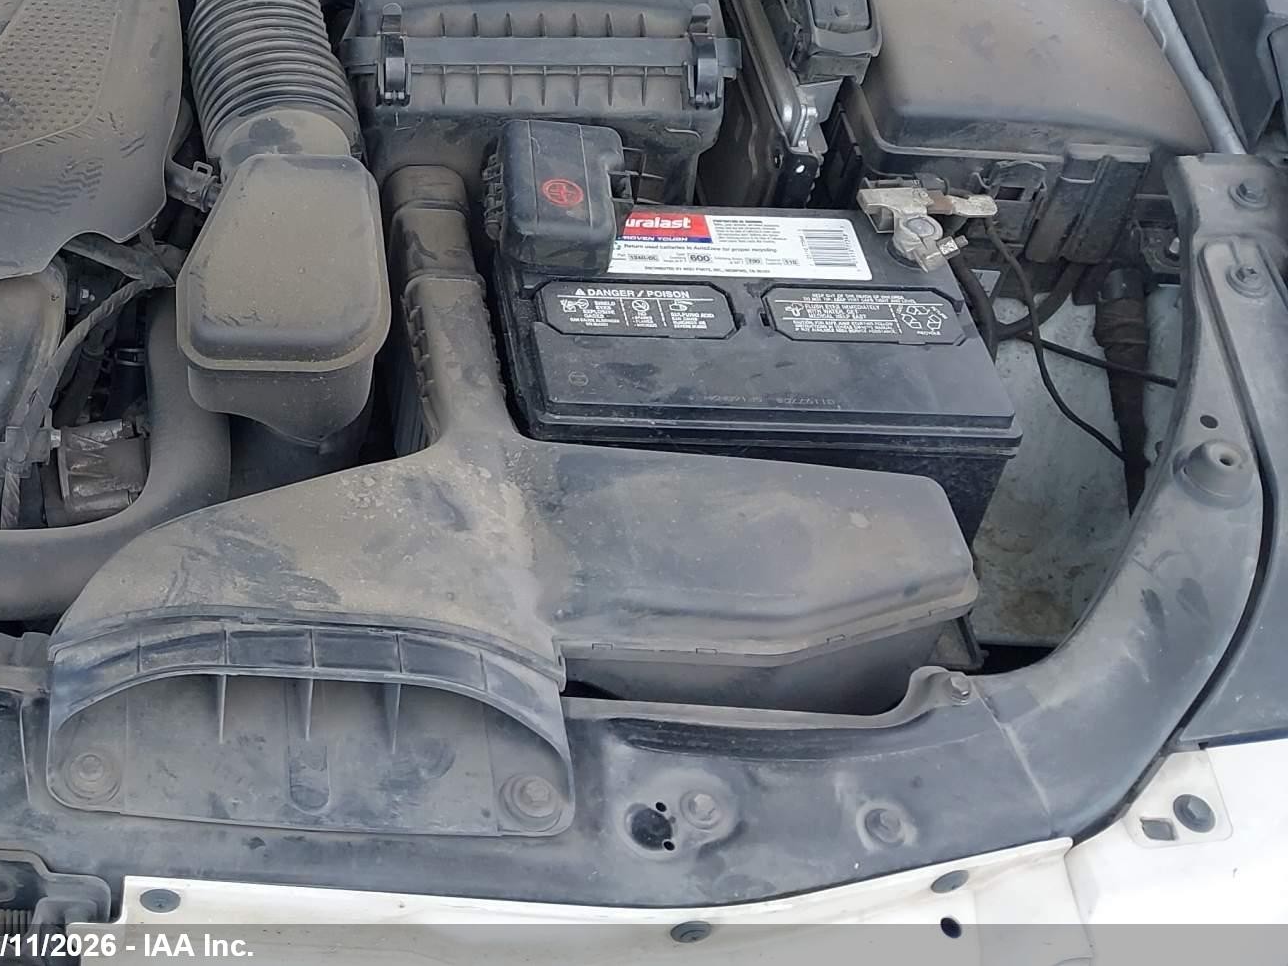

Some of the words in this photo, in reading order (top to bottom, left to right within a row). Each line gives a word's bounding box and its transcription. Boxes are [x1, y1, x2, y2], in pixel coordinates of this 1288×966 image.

[625, 216, 692, 229] uralast
[689, 254, 711, 262] 600
[586, 288, 635, 297] DANGER
[646, 290, 690, 299] POISON
